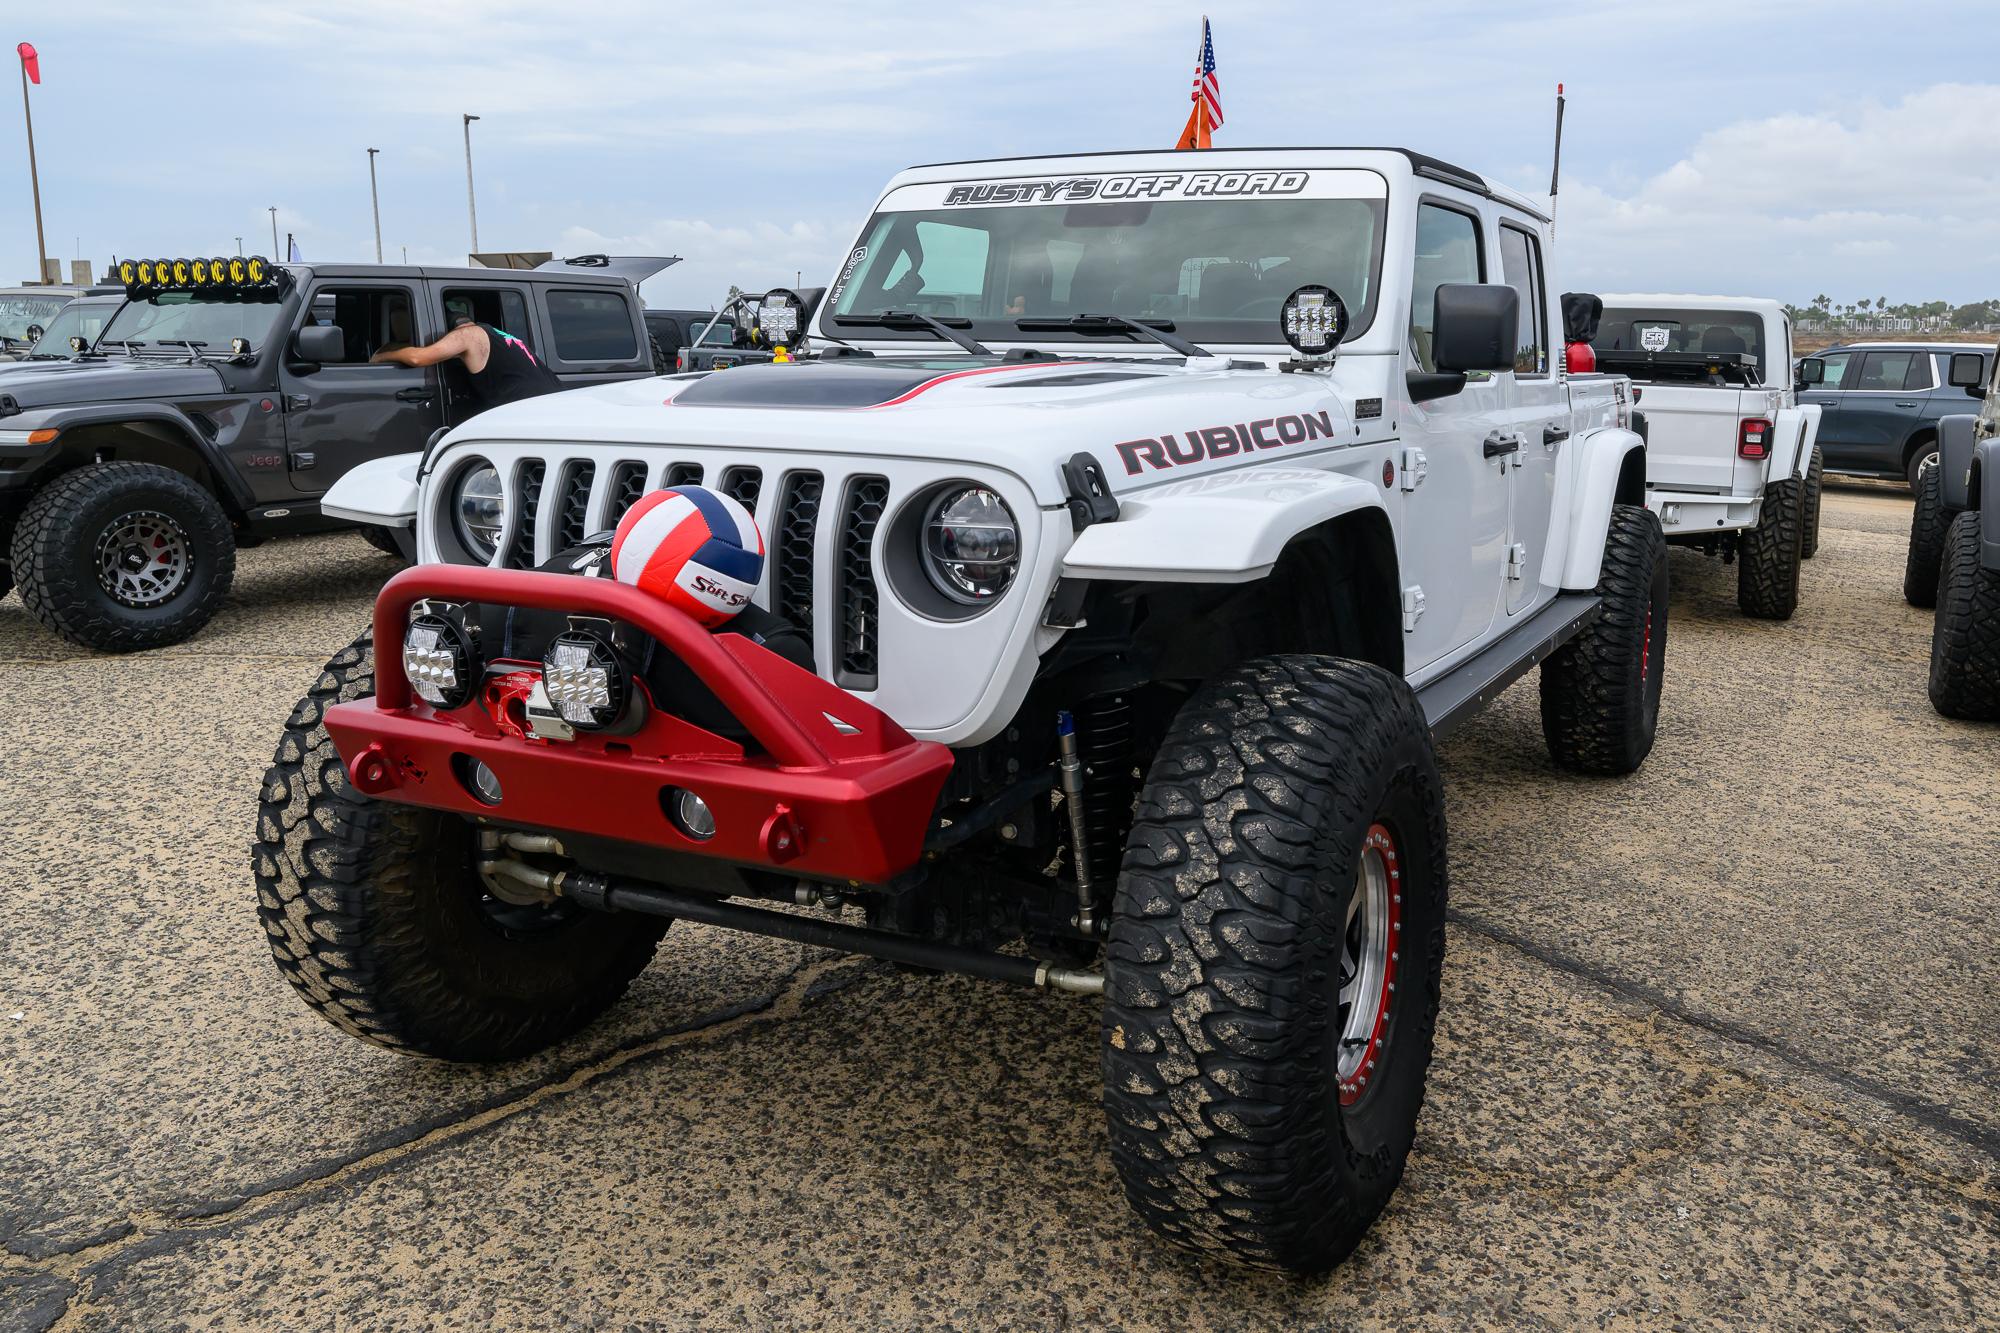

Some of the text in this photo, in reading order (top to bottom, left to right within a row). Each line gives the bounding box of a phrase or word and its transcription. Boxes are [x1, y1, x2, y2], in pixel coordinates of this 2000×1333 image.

[943, 172, 1310, 206] RUSTY'S OFF ROAD
[121, 263, 133, 283] KC
[138, 264, 151, 284] KC
[156, 263, 168, 283] KC
[174, 263, 186, 283] KC
[192, 262, 205, 283] KC
[211, 262, 224, 282] KC
[230, 262, 243, 282] KC
[249, 260, 262, 282] KC
[1645, 332, 1665, 341] SR
[1115, 411, 1335, 476] RUBICON
[247, 454, 281, 468] Jeep
[690, 575, 728, 601] Soft
